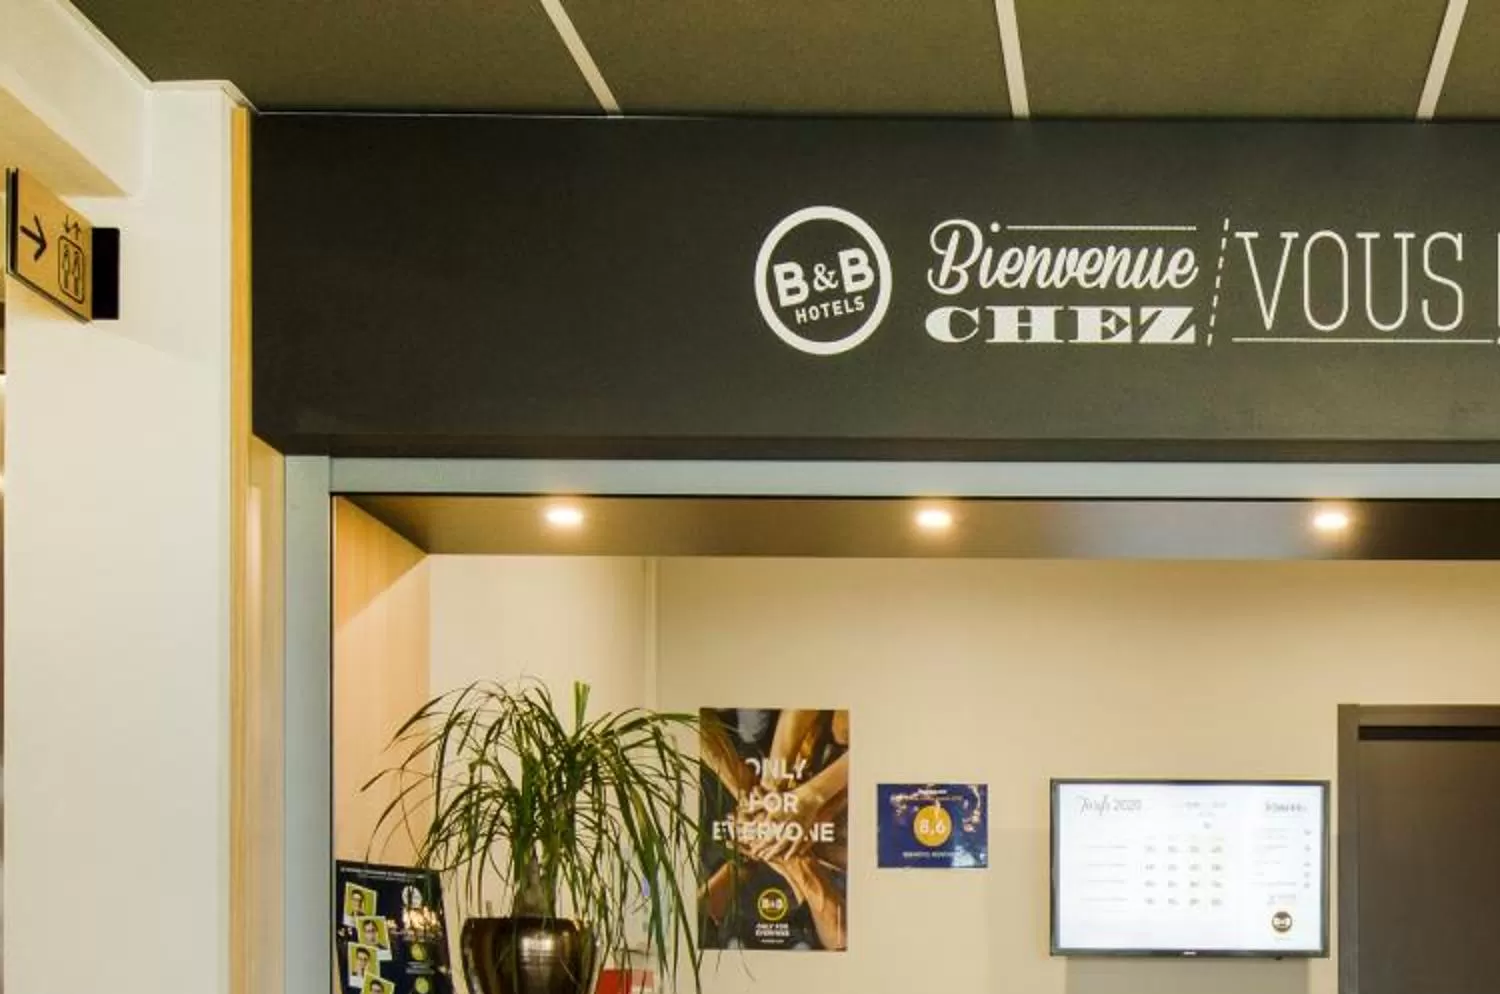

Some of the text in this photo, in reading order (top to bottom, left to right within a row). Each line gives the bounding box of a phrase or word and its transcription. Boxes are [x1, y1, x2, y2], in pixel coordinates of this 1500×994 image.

[772, 247, 875, 308] B&B
[927, 219, 1199, 295] Bienvenue
[1234, 229, 1464, 332] VOUS
[795, 295, 866, 325] HOTELS
[925, 305, 1197, 344] CHEZ
